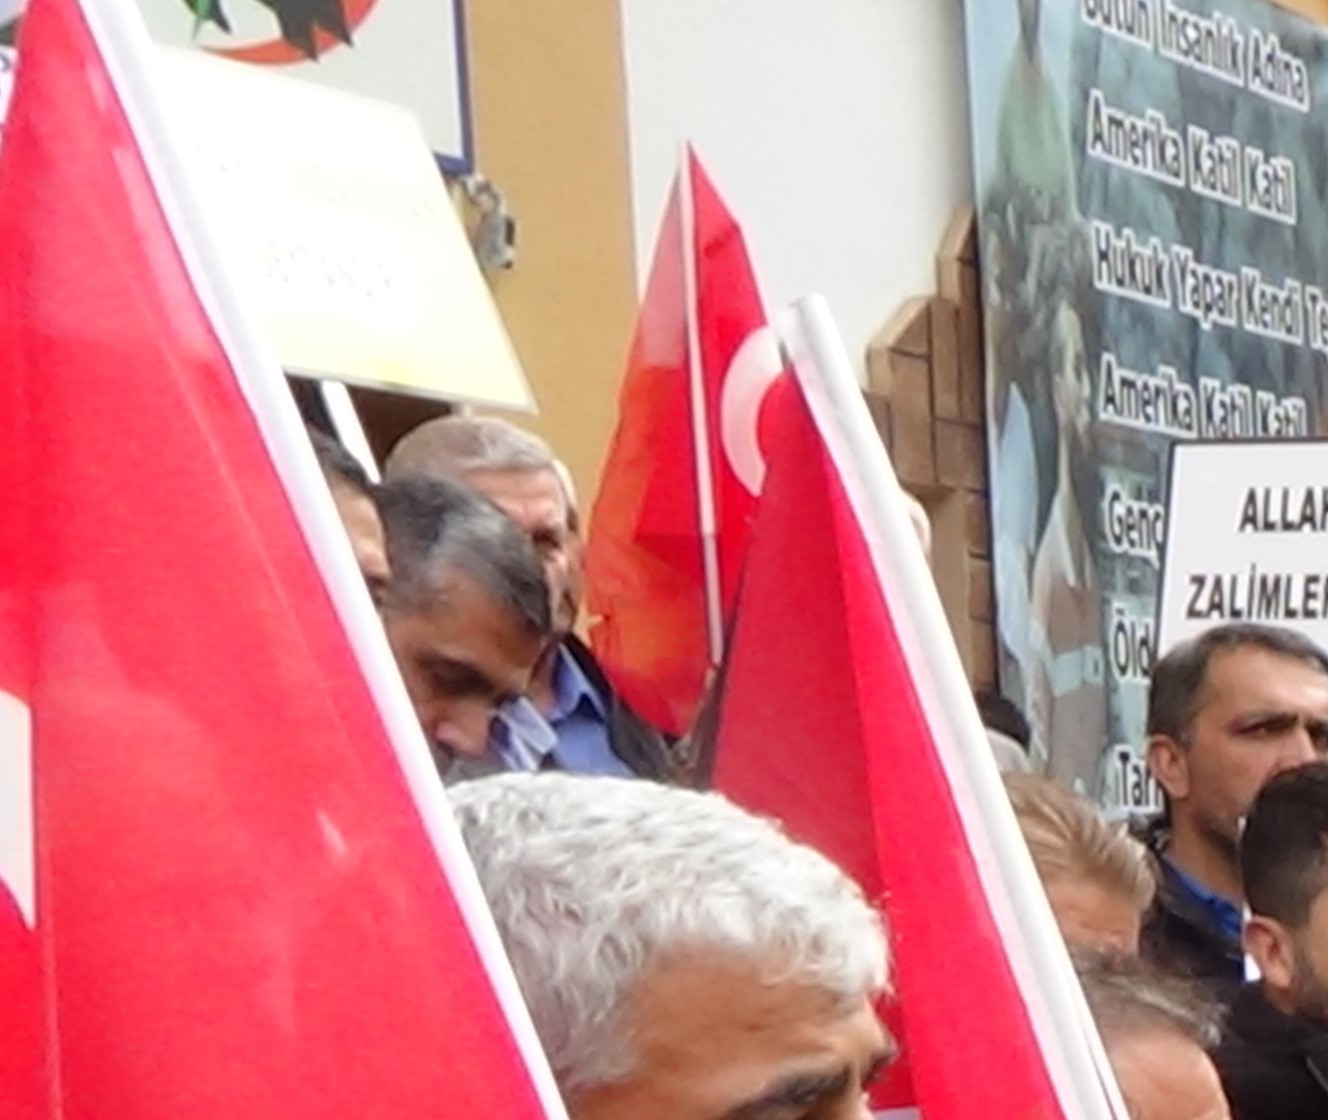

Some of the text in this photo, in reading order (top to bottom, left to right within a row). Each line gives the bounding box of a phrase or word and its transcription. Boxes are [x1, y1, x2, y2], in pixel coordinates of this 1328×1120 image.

[1248, 28, 1310, 113] Adına
[1087, 88, 1297, 226] Amerika Katil Katil
[1091, 219, 1171, 309] Hukuk
[1172, 244, 1239, 331] Yapar
[1240, 266, 1304, 345] Kendi
[1099, 352, 1198, 438] Amerika
